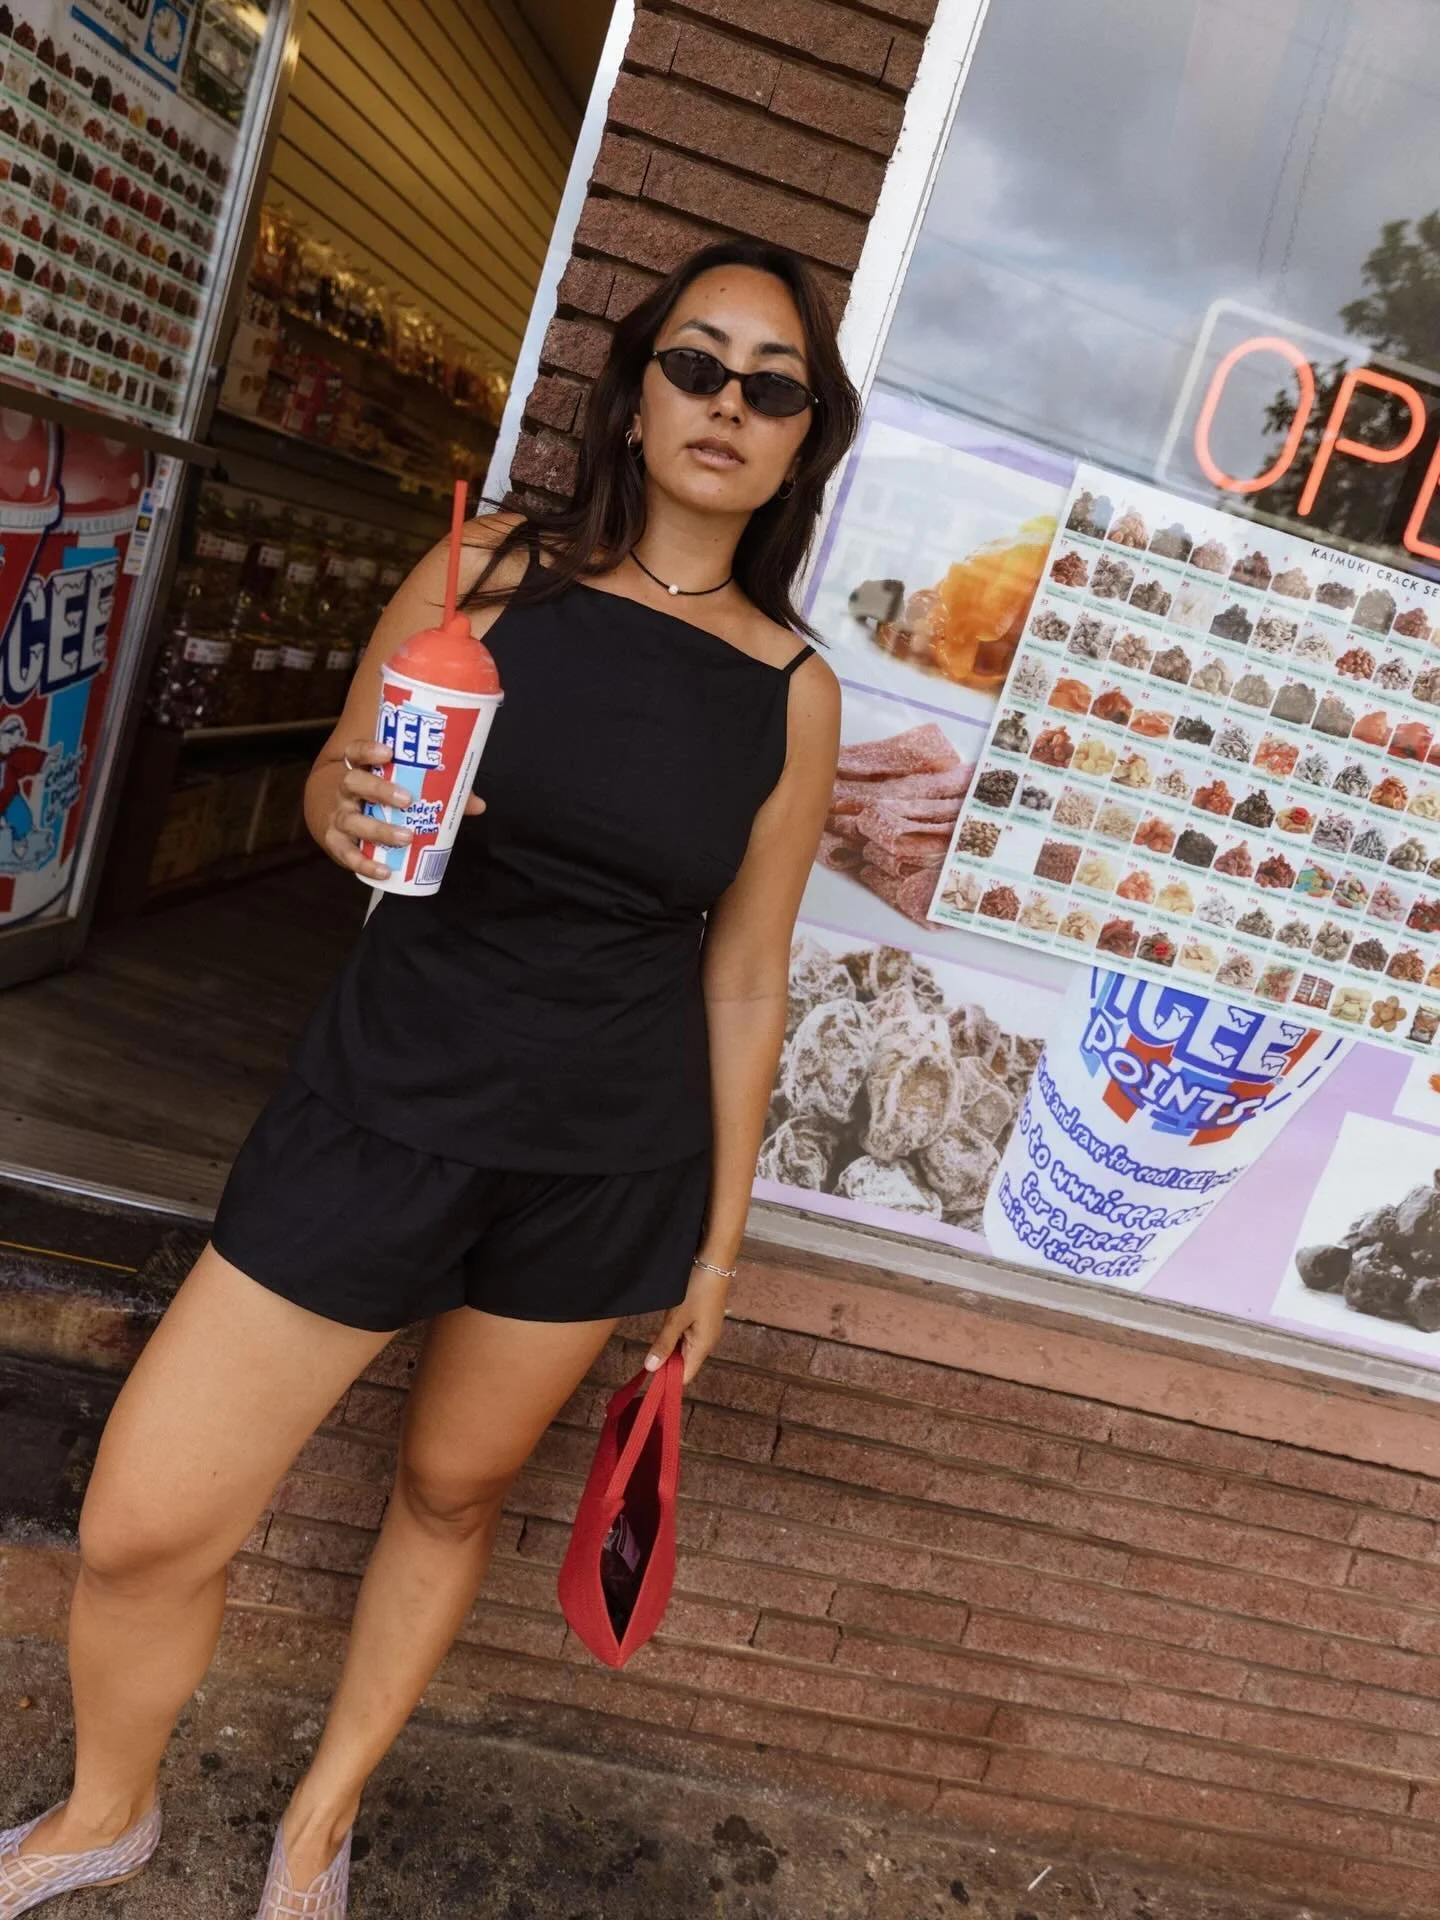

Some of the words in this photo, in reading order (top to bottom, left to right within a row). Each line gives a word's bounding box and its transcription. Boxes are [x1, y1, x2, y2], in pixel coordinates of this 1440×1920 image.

[1311, 547, 1370, 574] KAIMUKI
[1376, 569, 1418, 591] CRACK
[3, 562, 118, 697] CEE
[406, 816, 435, 827] Drink
[415, 825, 440, 835] Town
[1082, 1010, 1266, 1127] POINTS
[1028, 1122, 1051, 1171] to
[1050, 1092, 1081, 1134] and
[1070, 1122, 1111, 1163] save
[1104, 1144, 1140, 1176] for
[1133, 1166, 1175, 1188] cool
[998, 1171, 1051, 1250] limited
[1043, 1237, 1095, 1275] time
[1021, 1171, 1052, 1216] for
[1048, 1207, 1067, 1232] a
[1065, 1222, 1157, 1254] special
